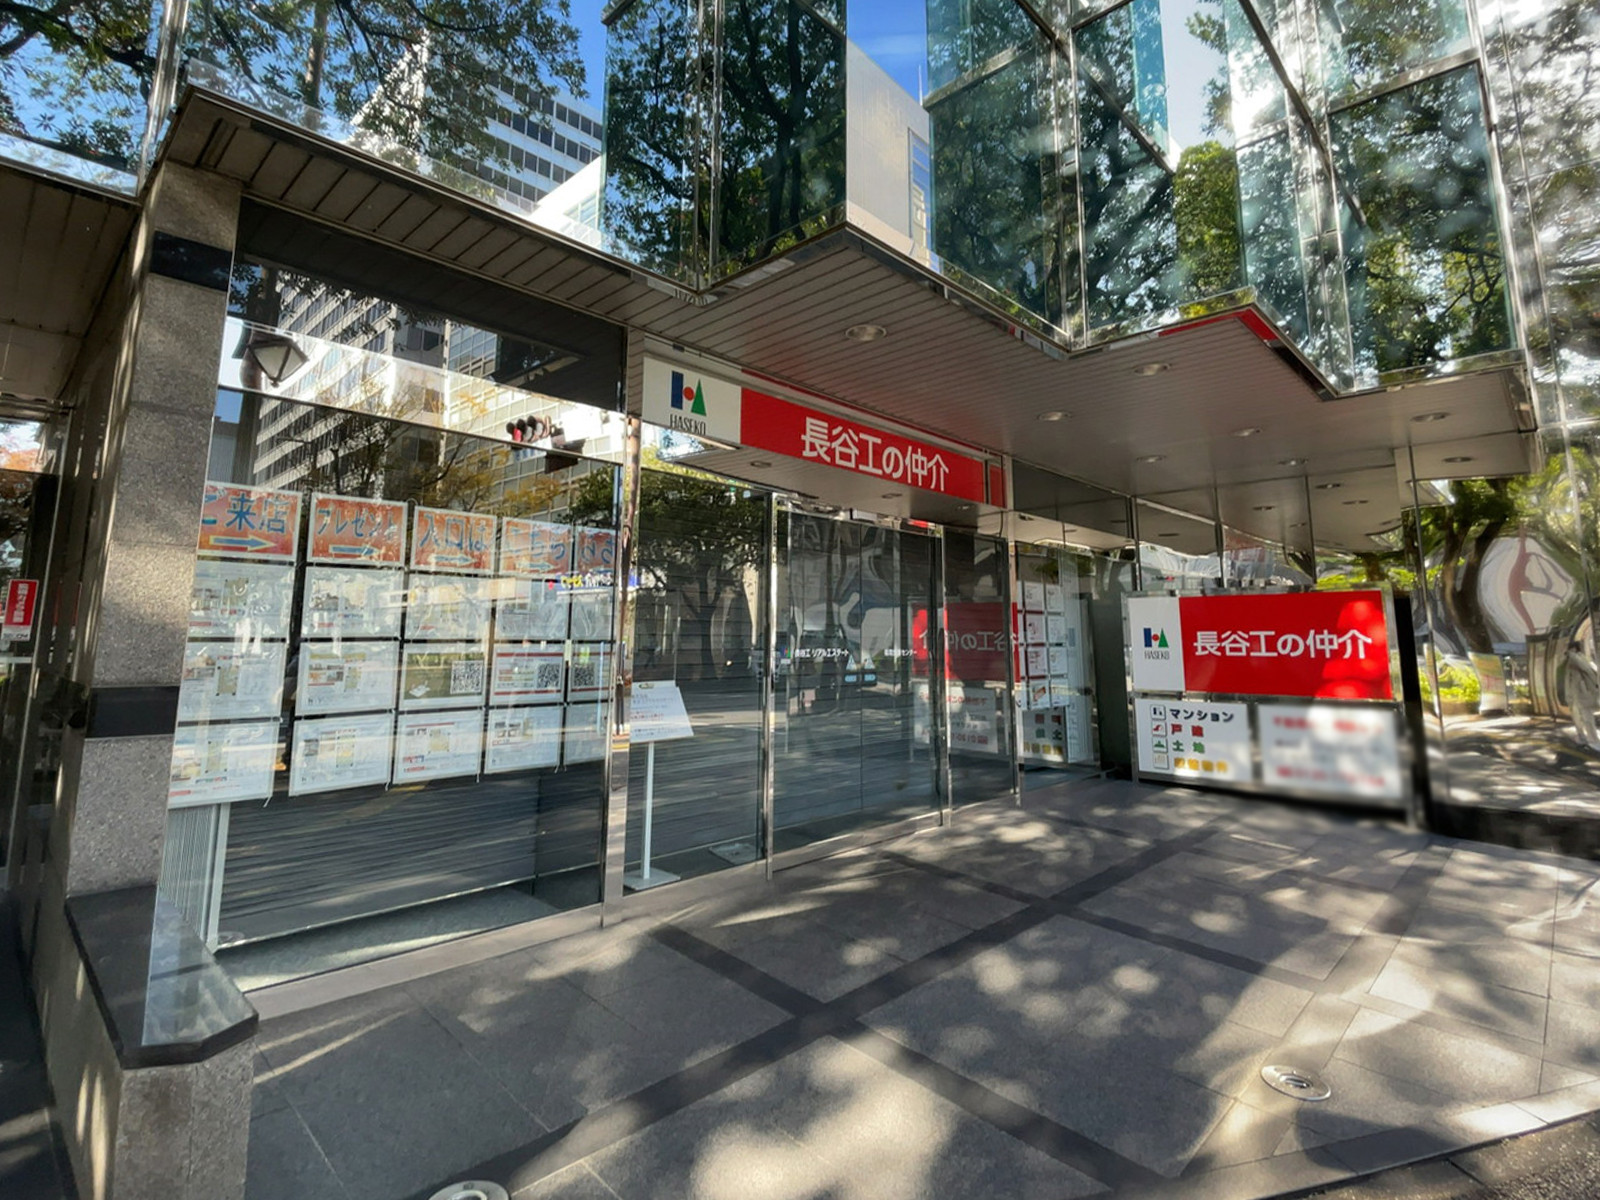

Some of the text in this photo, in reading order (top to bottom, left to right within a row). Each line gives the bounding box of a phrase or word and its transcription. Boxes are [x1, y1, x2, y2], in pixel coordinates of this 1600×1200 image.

[670, 414, 706, 436] HASEKO
[801, 416, 949, 492] 長谷工の仲介
[316, 503, 398, 541] プレゼント
[419, 513, 488, 552] 入口は
[1144, 650, 1170, 660] HASEKO
[1194, 629, 1372, 659] 長谷工の仲介
[1169, 708, 1234, 723] マンション
